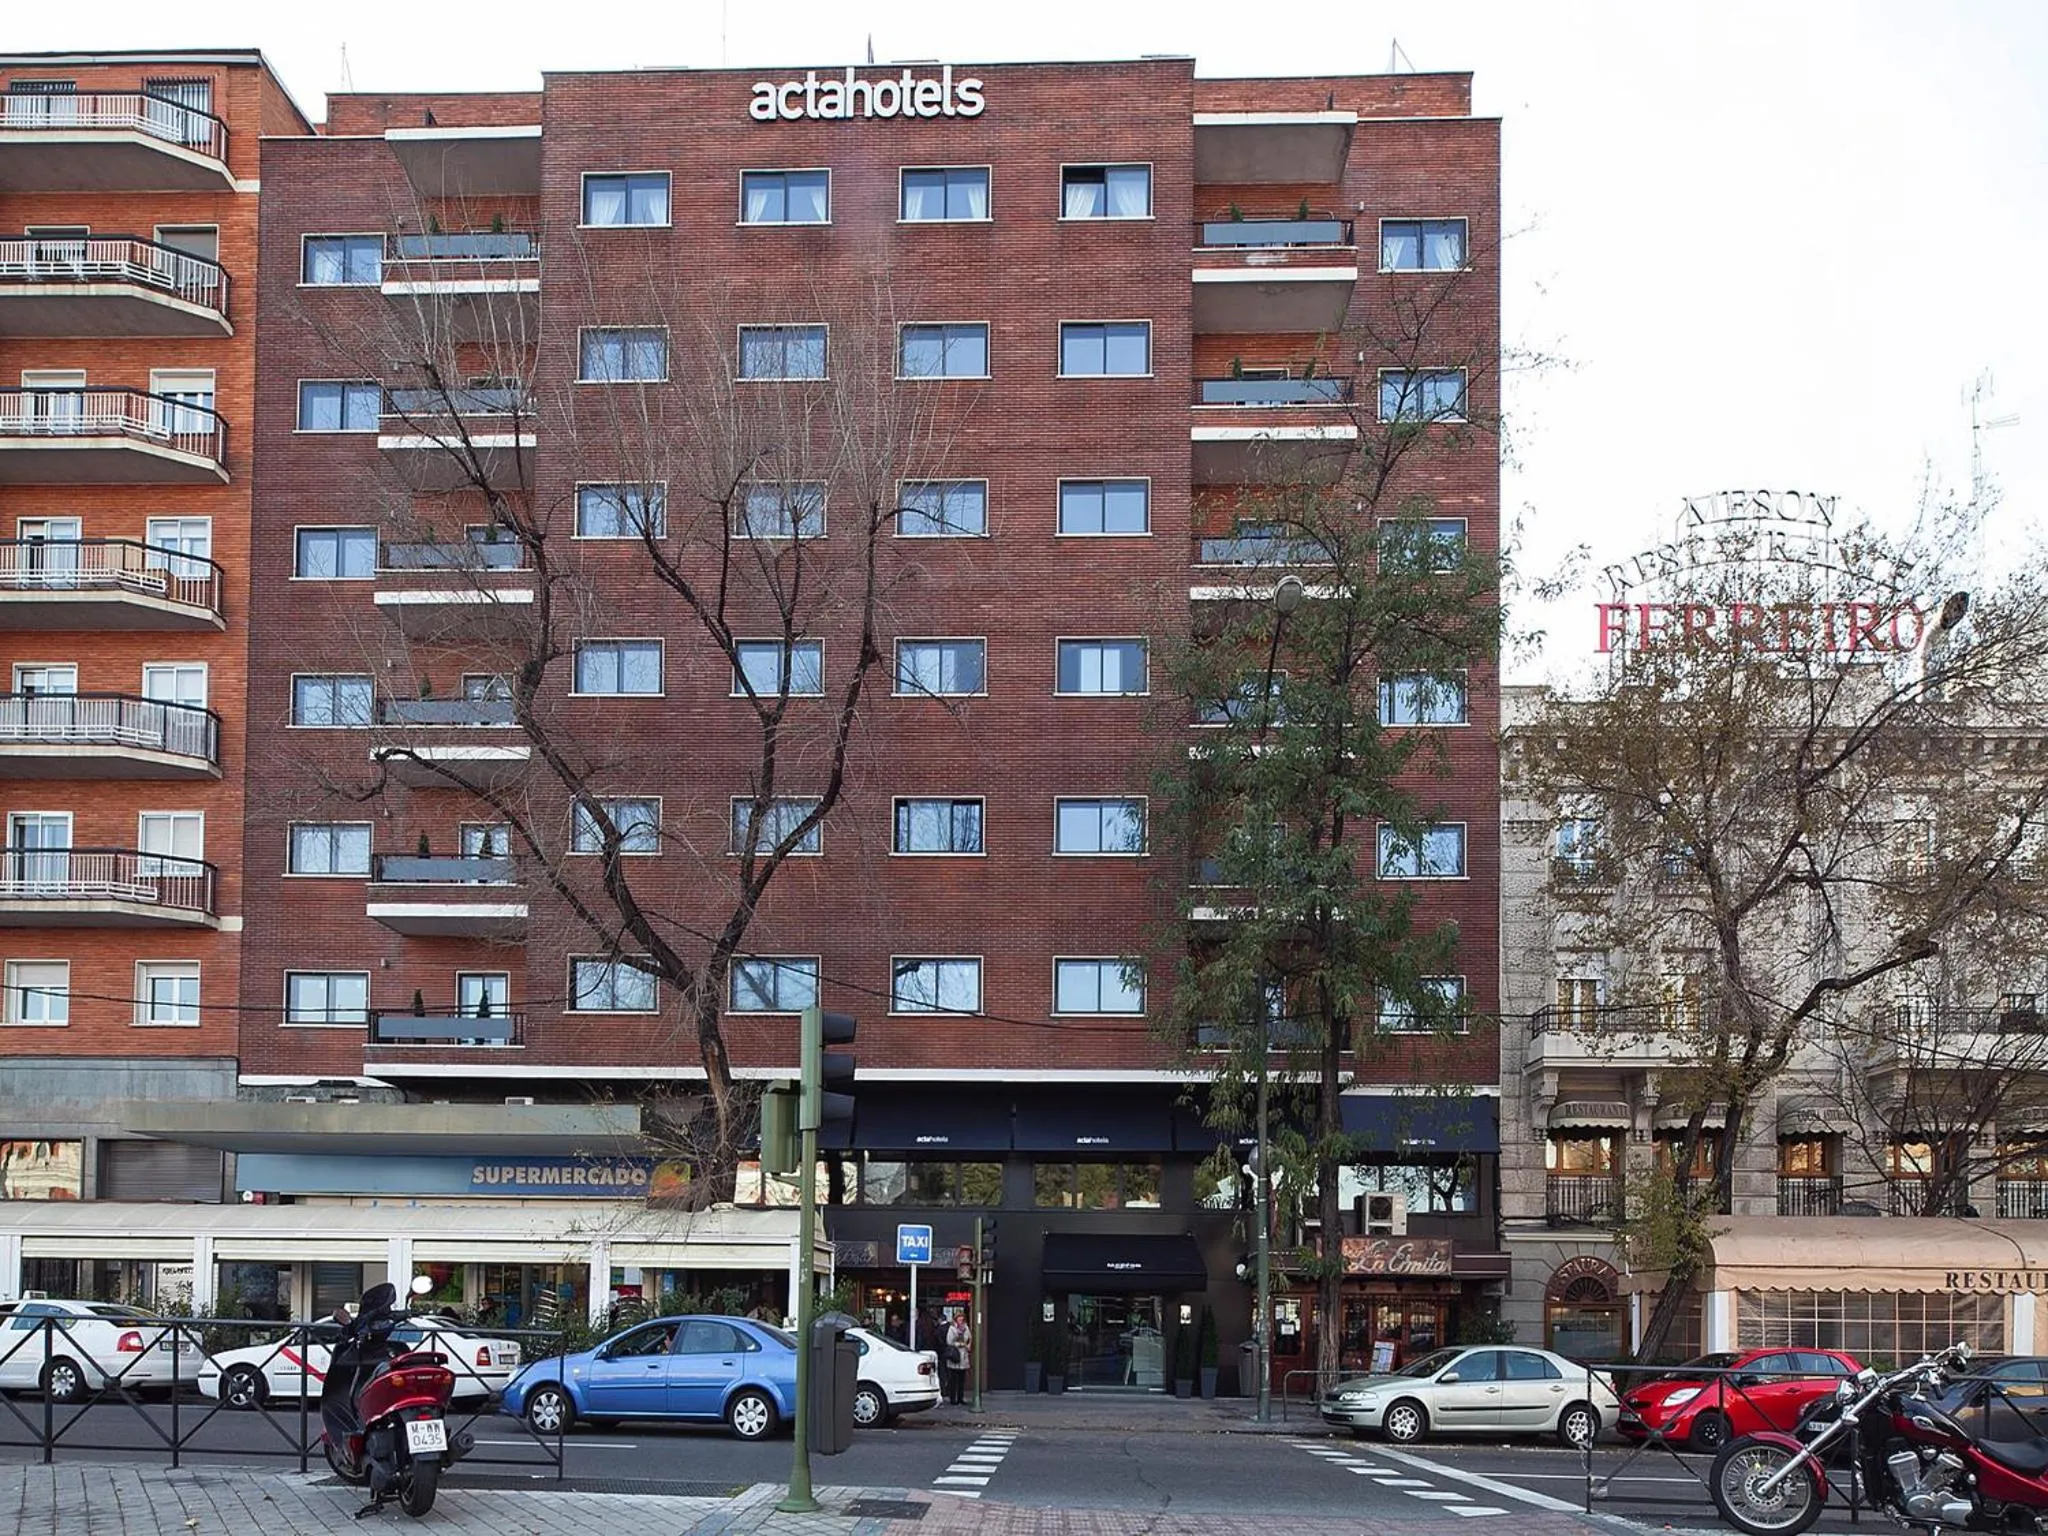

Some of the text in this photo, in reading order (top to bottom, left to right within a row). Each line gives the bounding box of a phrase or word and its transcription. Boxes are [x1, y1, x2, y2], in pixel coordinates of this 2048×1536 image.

[749, 65, 985, 121] actahotels
[1593, 601, 1925, 654] FERREIRO
[472, 1166, 647, 1186] SUPERMERCADO
[901, 1235, 928, 1249] TAXI
[1944, 1271, 2048, 1289] RESTAU
